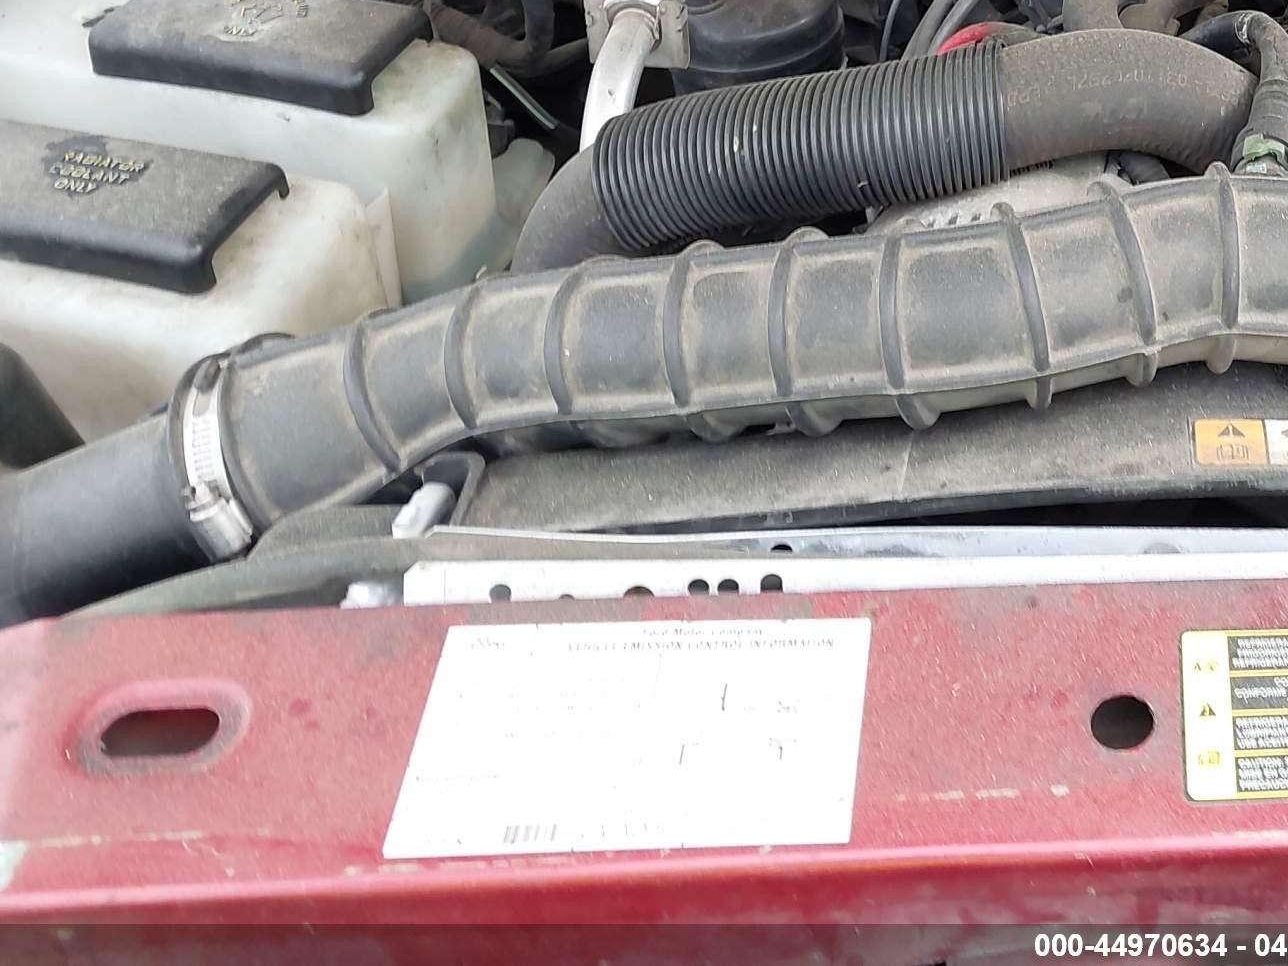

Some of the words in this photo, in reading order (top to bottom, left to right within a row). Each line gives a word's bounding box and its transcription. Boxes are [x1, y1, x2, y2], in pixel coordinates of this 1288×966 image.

[63, 150, 146, 172] RADIATOR
[48, 162, 131, 184] COOLANT
[53, 177, 98, 193] ONLY
